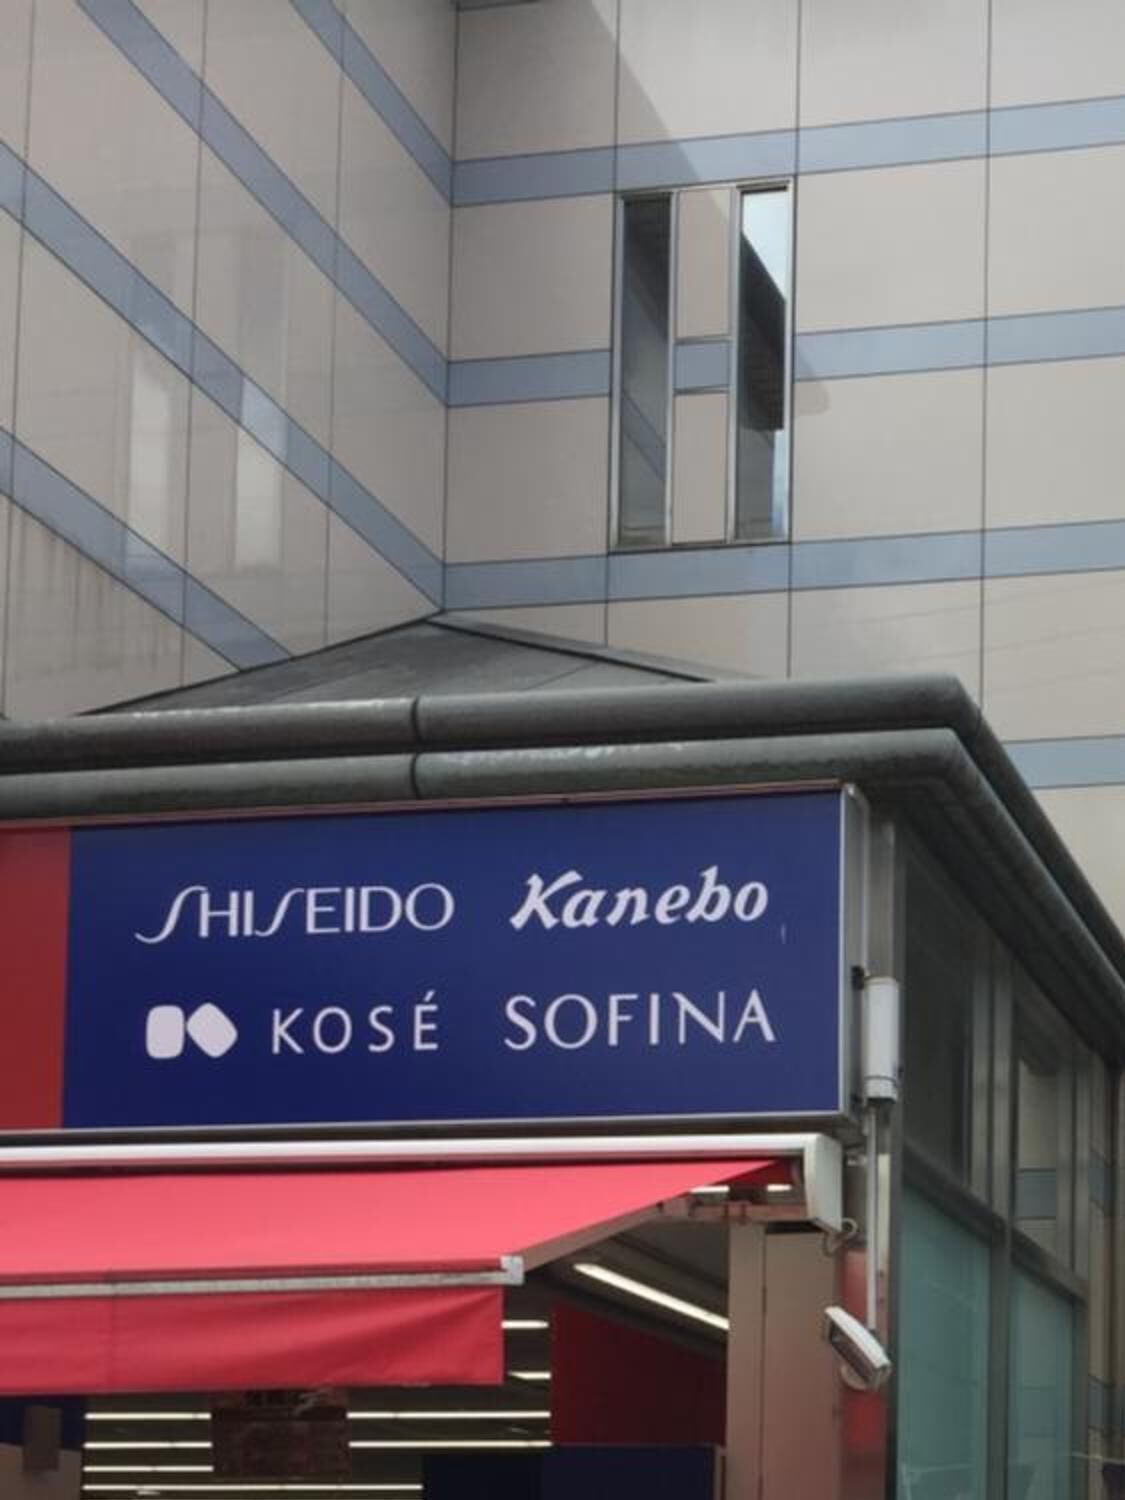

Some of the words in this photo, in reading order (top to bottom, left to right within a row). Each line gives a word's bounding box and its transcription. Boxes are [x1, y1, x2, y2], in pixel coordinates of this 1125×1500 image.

[135, 882, 455, 944] SHISEIDO
[509, 866, 769, 930] Kanebo
[271, 989, 440, 1055] KOSÉ
[504, 989, 776, 1050] SOFINA
